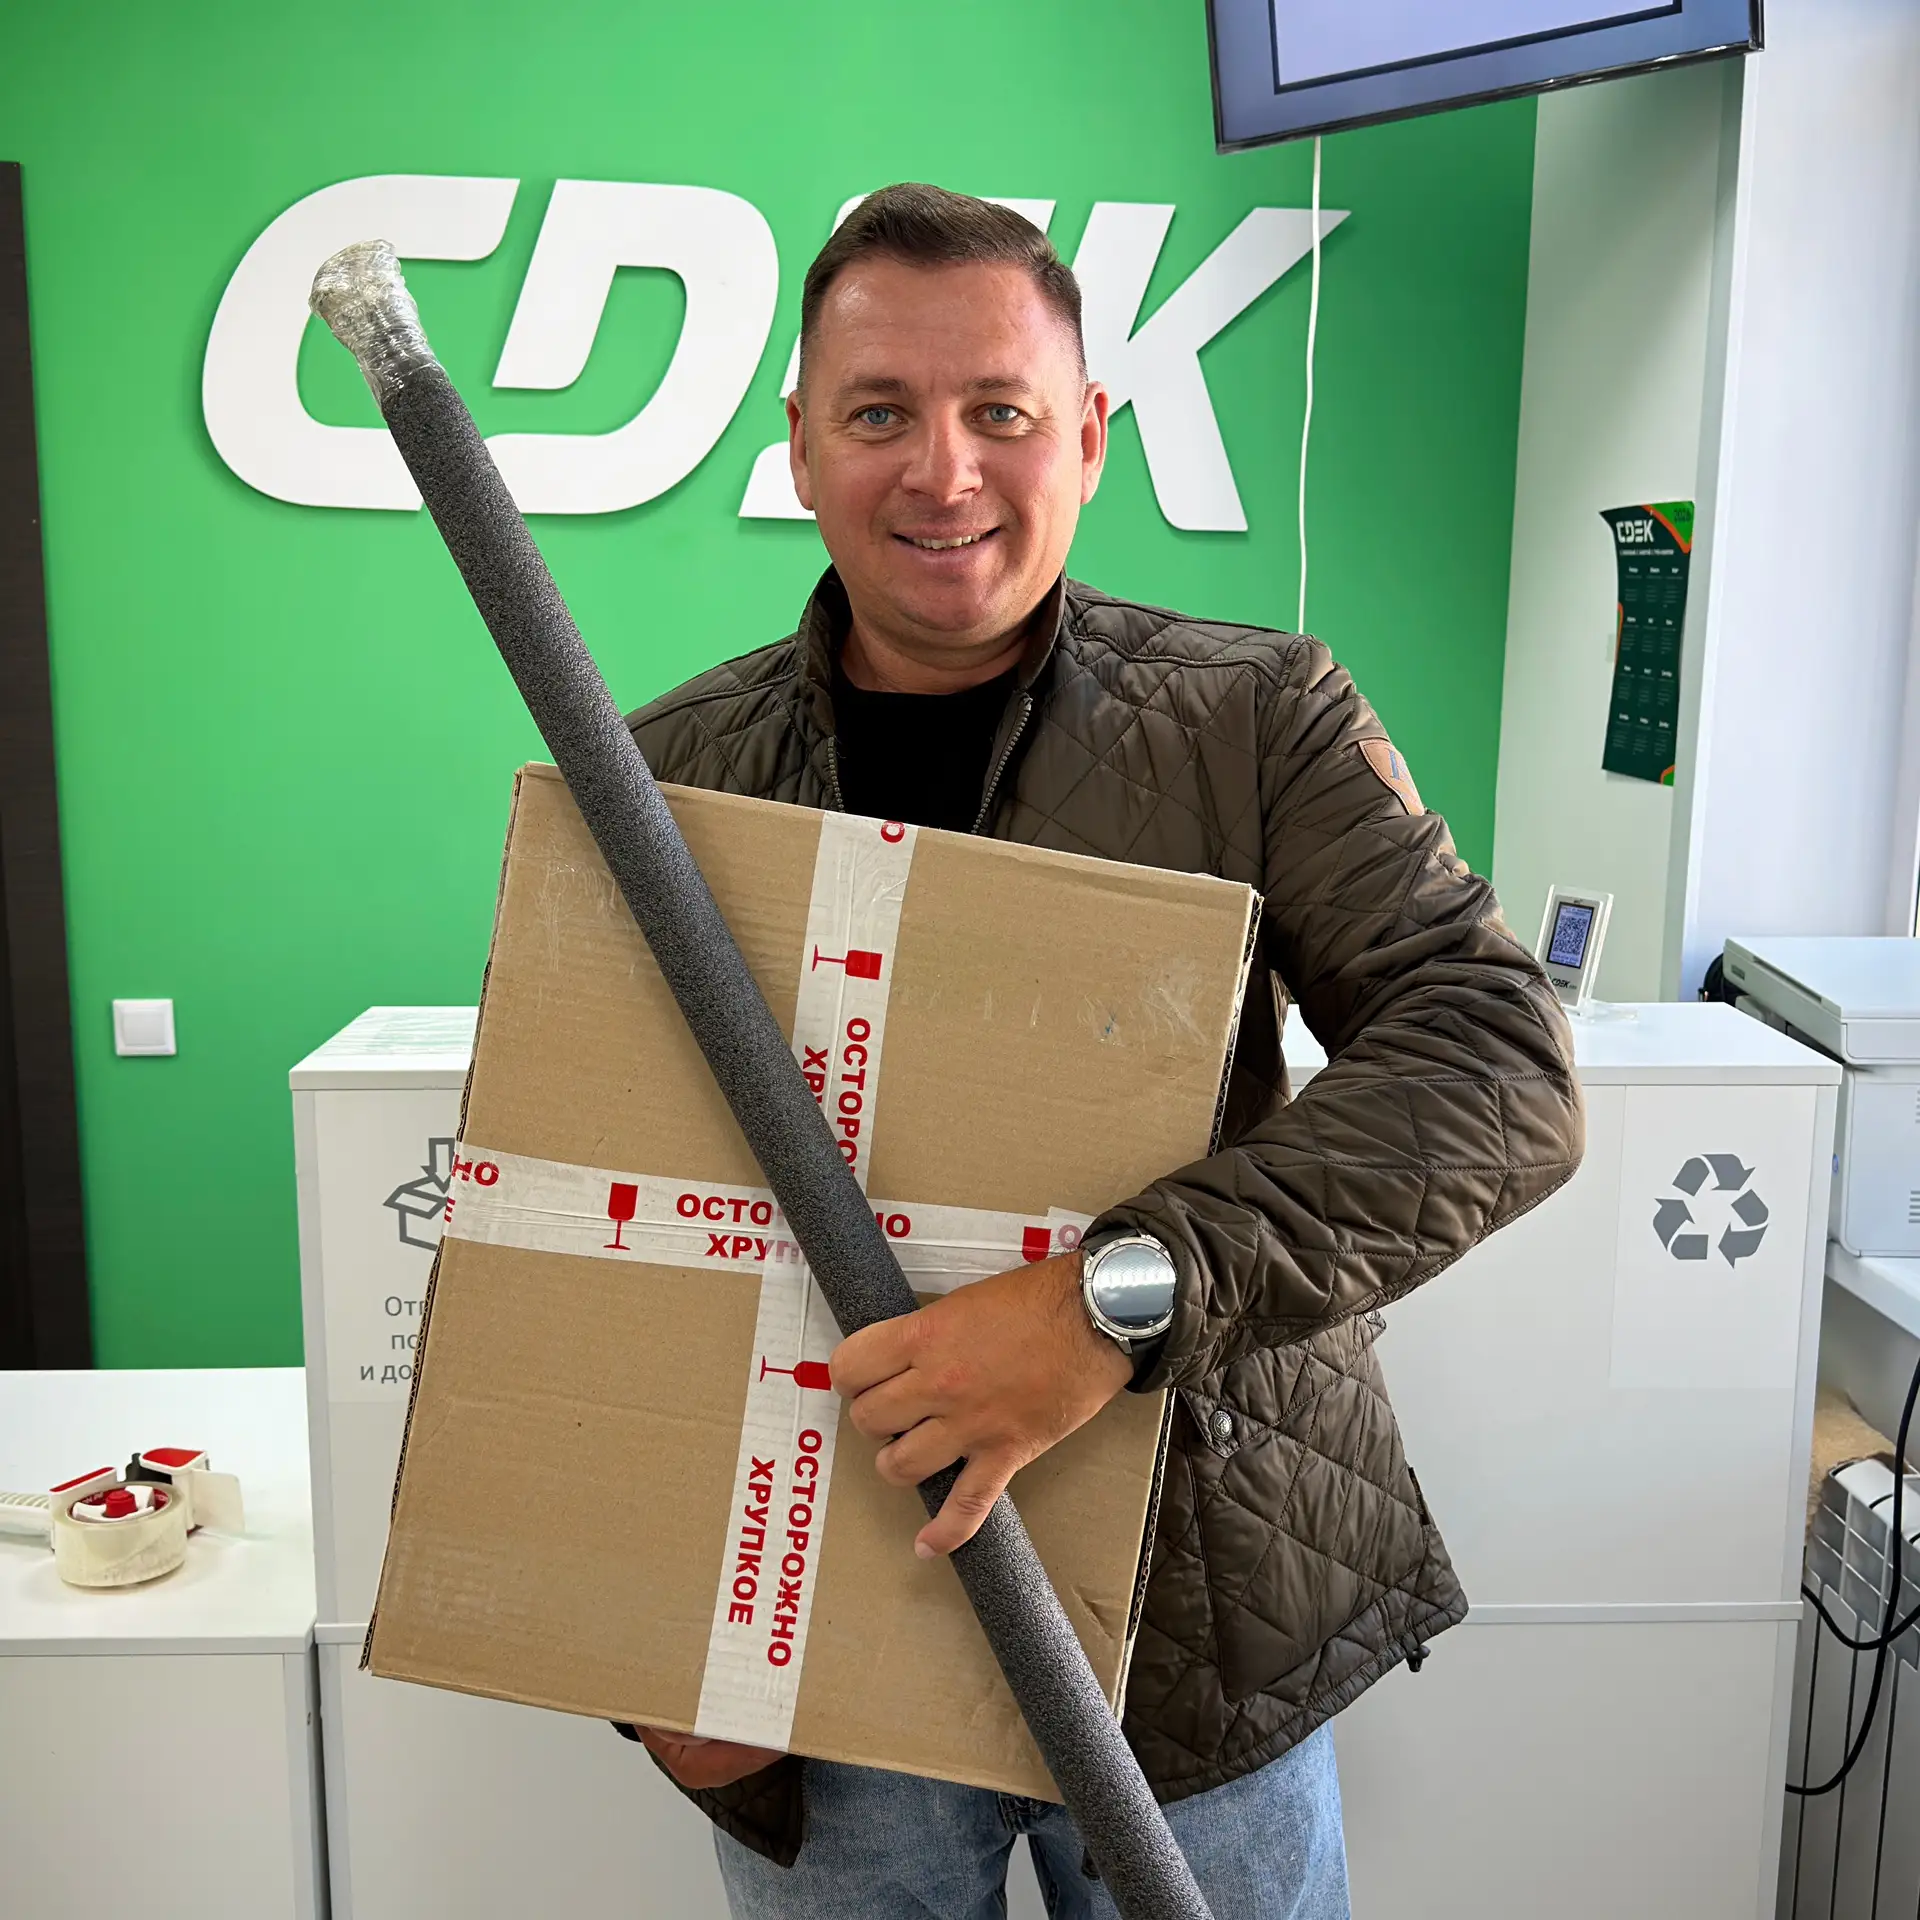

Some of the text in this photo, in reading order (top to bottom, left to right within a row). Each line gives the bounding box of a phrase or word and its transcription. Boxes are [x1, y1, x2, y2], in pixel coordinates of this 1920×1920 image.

[1616, 519, 1655, 544] CDEK
[1551, 977, 1570, 989] CDEK
[836, 1017, 871, 1175] ОСТОРО
[360, 1364, 413, 1384] и до
[728, 1455, 776, 1626] ХРУПКОЕ
[767, 1428, 823, 1667] ОСТОРОЖНО
